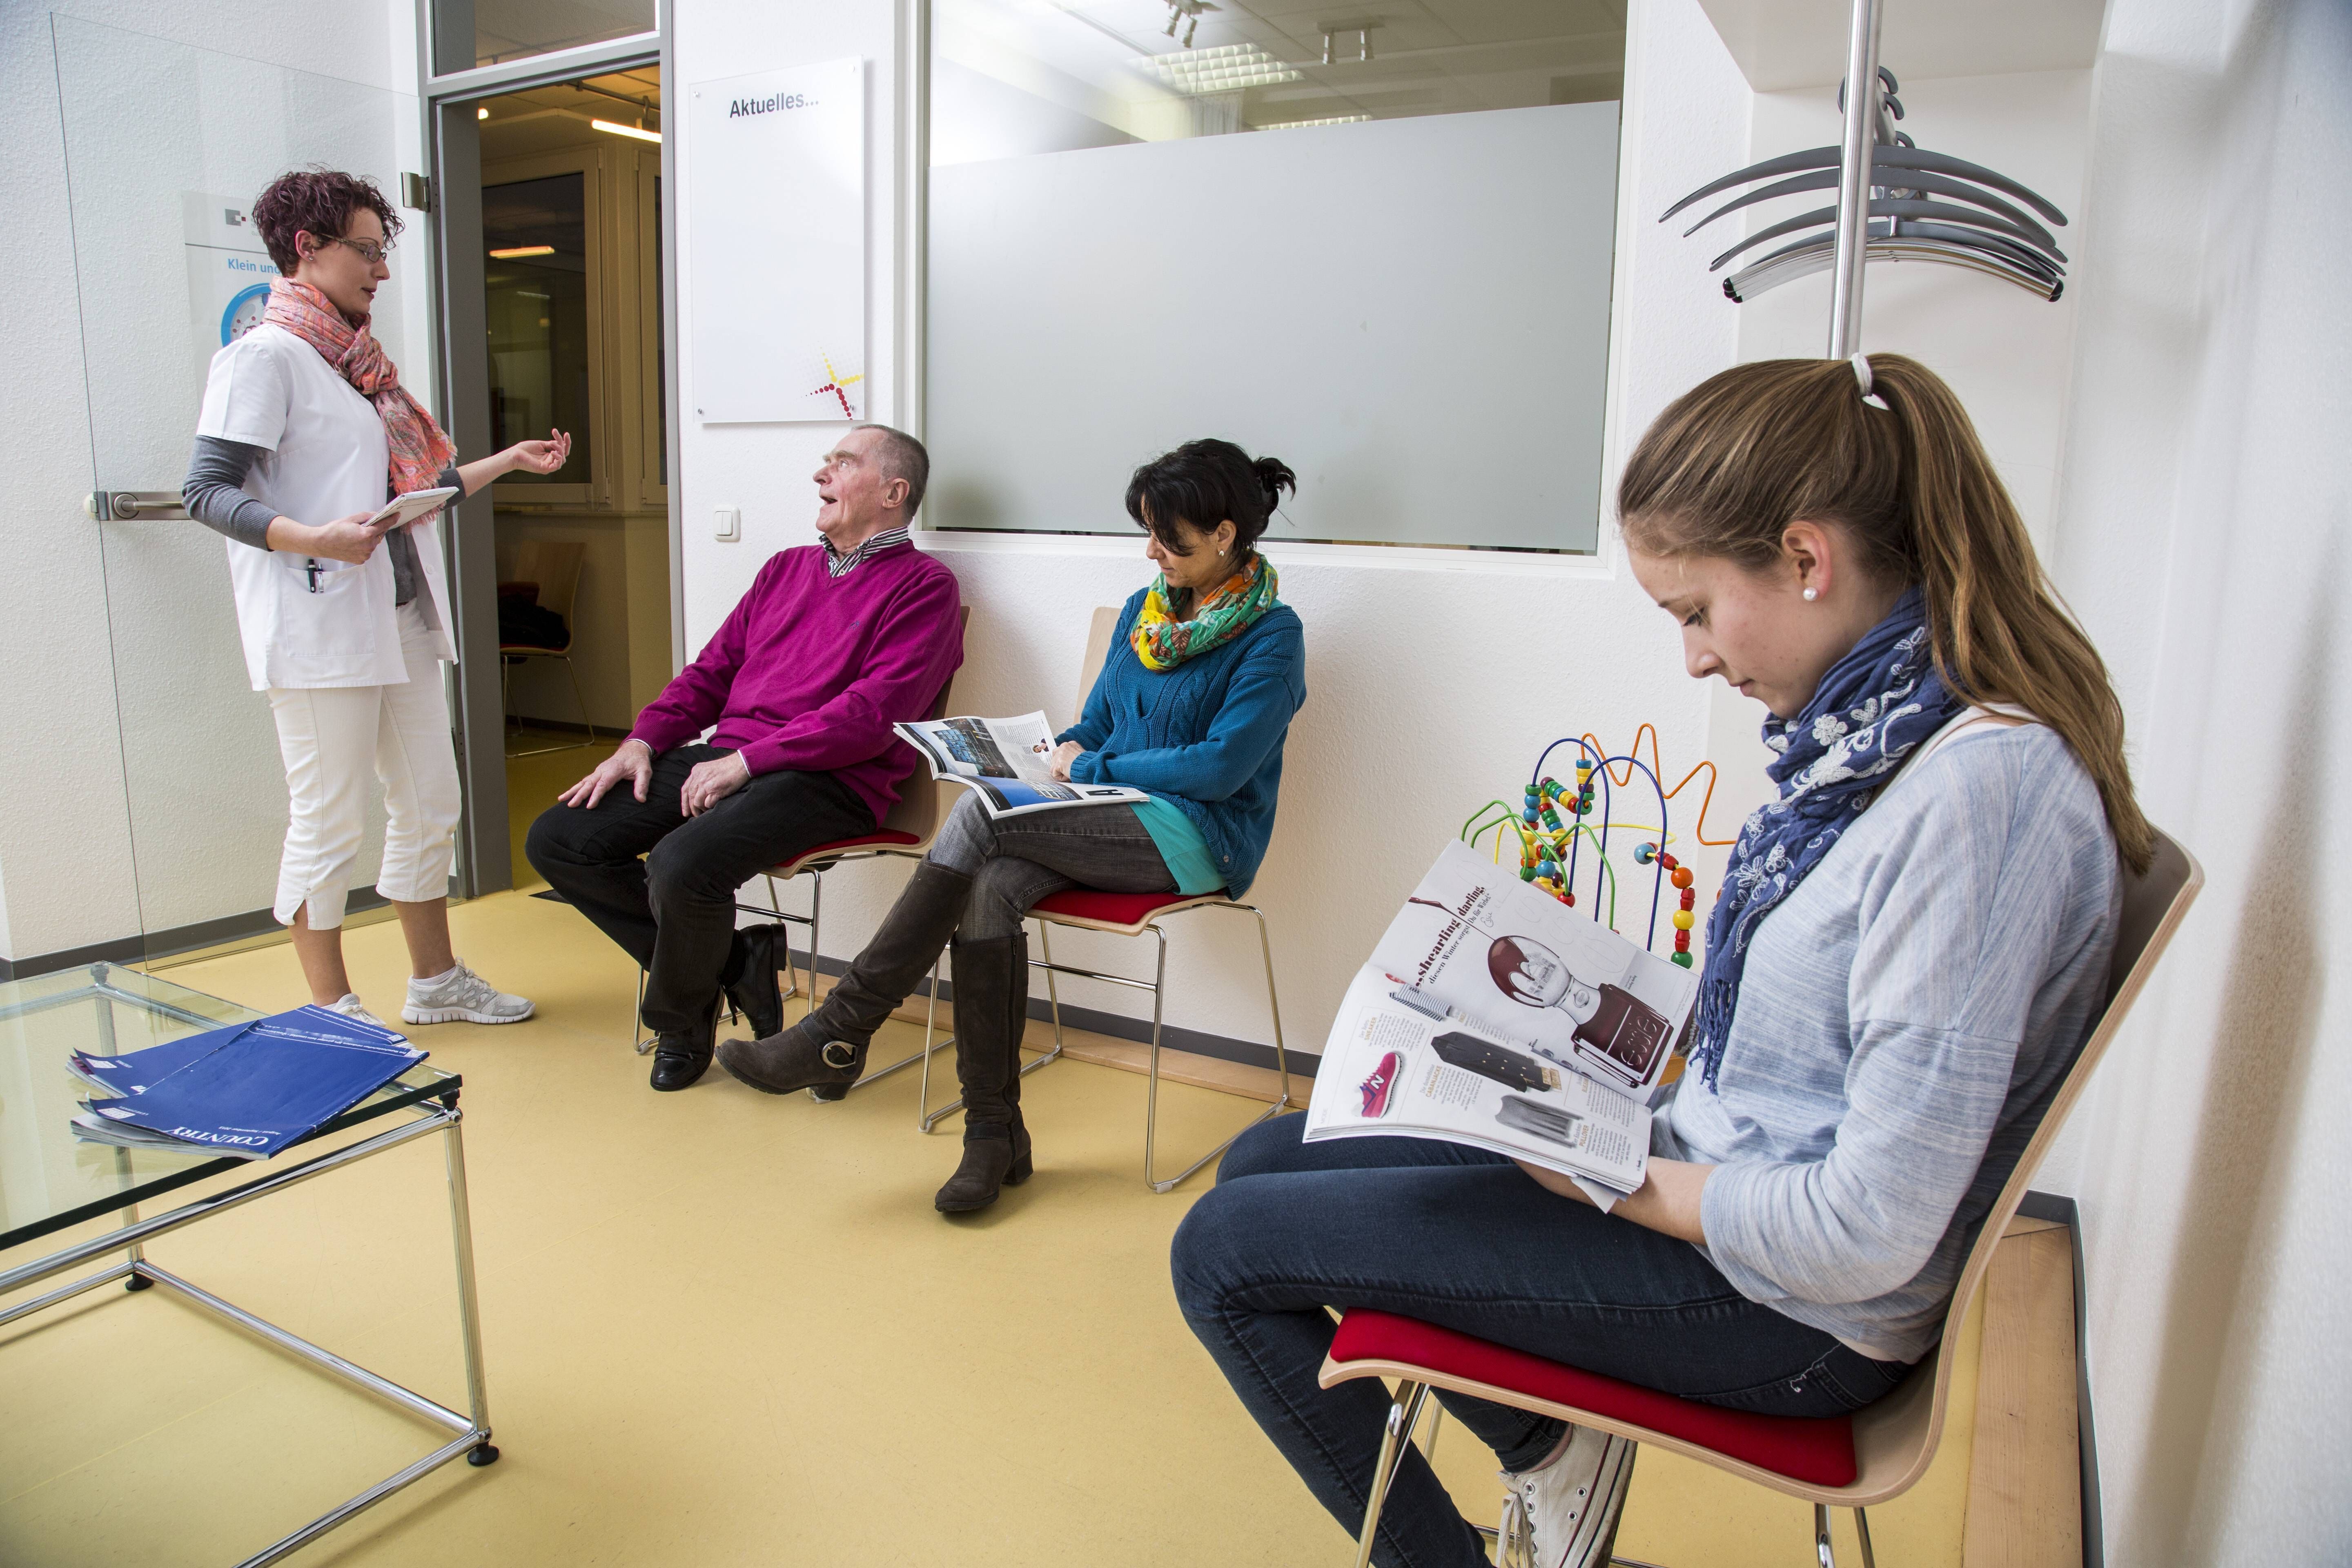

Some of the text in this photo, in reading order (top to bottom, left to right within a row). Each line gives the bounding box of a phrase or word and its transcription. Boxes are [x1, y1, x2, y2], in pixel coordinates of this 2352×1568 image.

[730, 93, 819, 118] Aktuelles...
[228, 258, 257, 272] Klein
[1457, 886, 1486, 916] darling,
[1429, 962, 1446, 984] diesen
[1442, 941, 1460, 960] Winter
[1459, 924, 1471, 941] sorgst
[1467, 914, 1477, 924] Du
[1364, 1017, 1377, 1040] SNEAKER
[1621, 1016, 1657, 1066] essie
[1370, 1074, 1385, 1090] N
[1425, 1065, 1442, 1098] CABANJACKE
[165, 1126, 269, 1146] COUNTRY
[1579, 1125, 1589, 1147] PULLOVER
